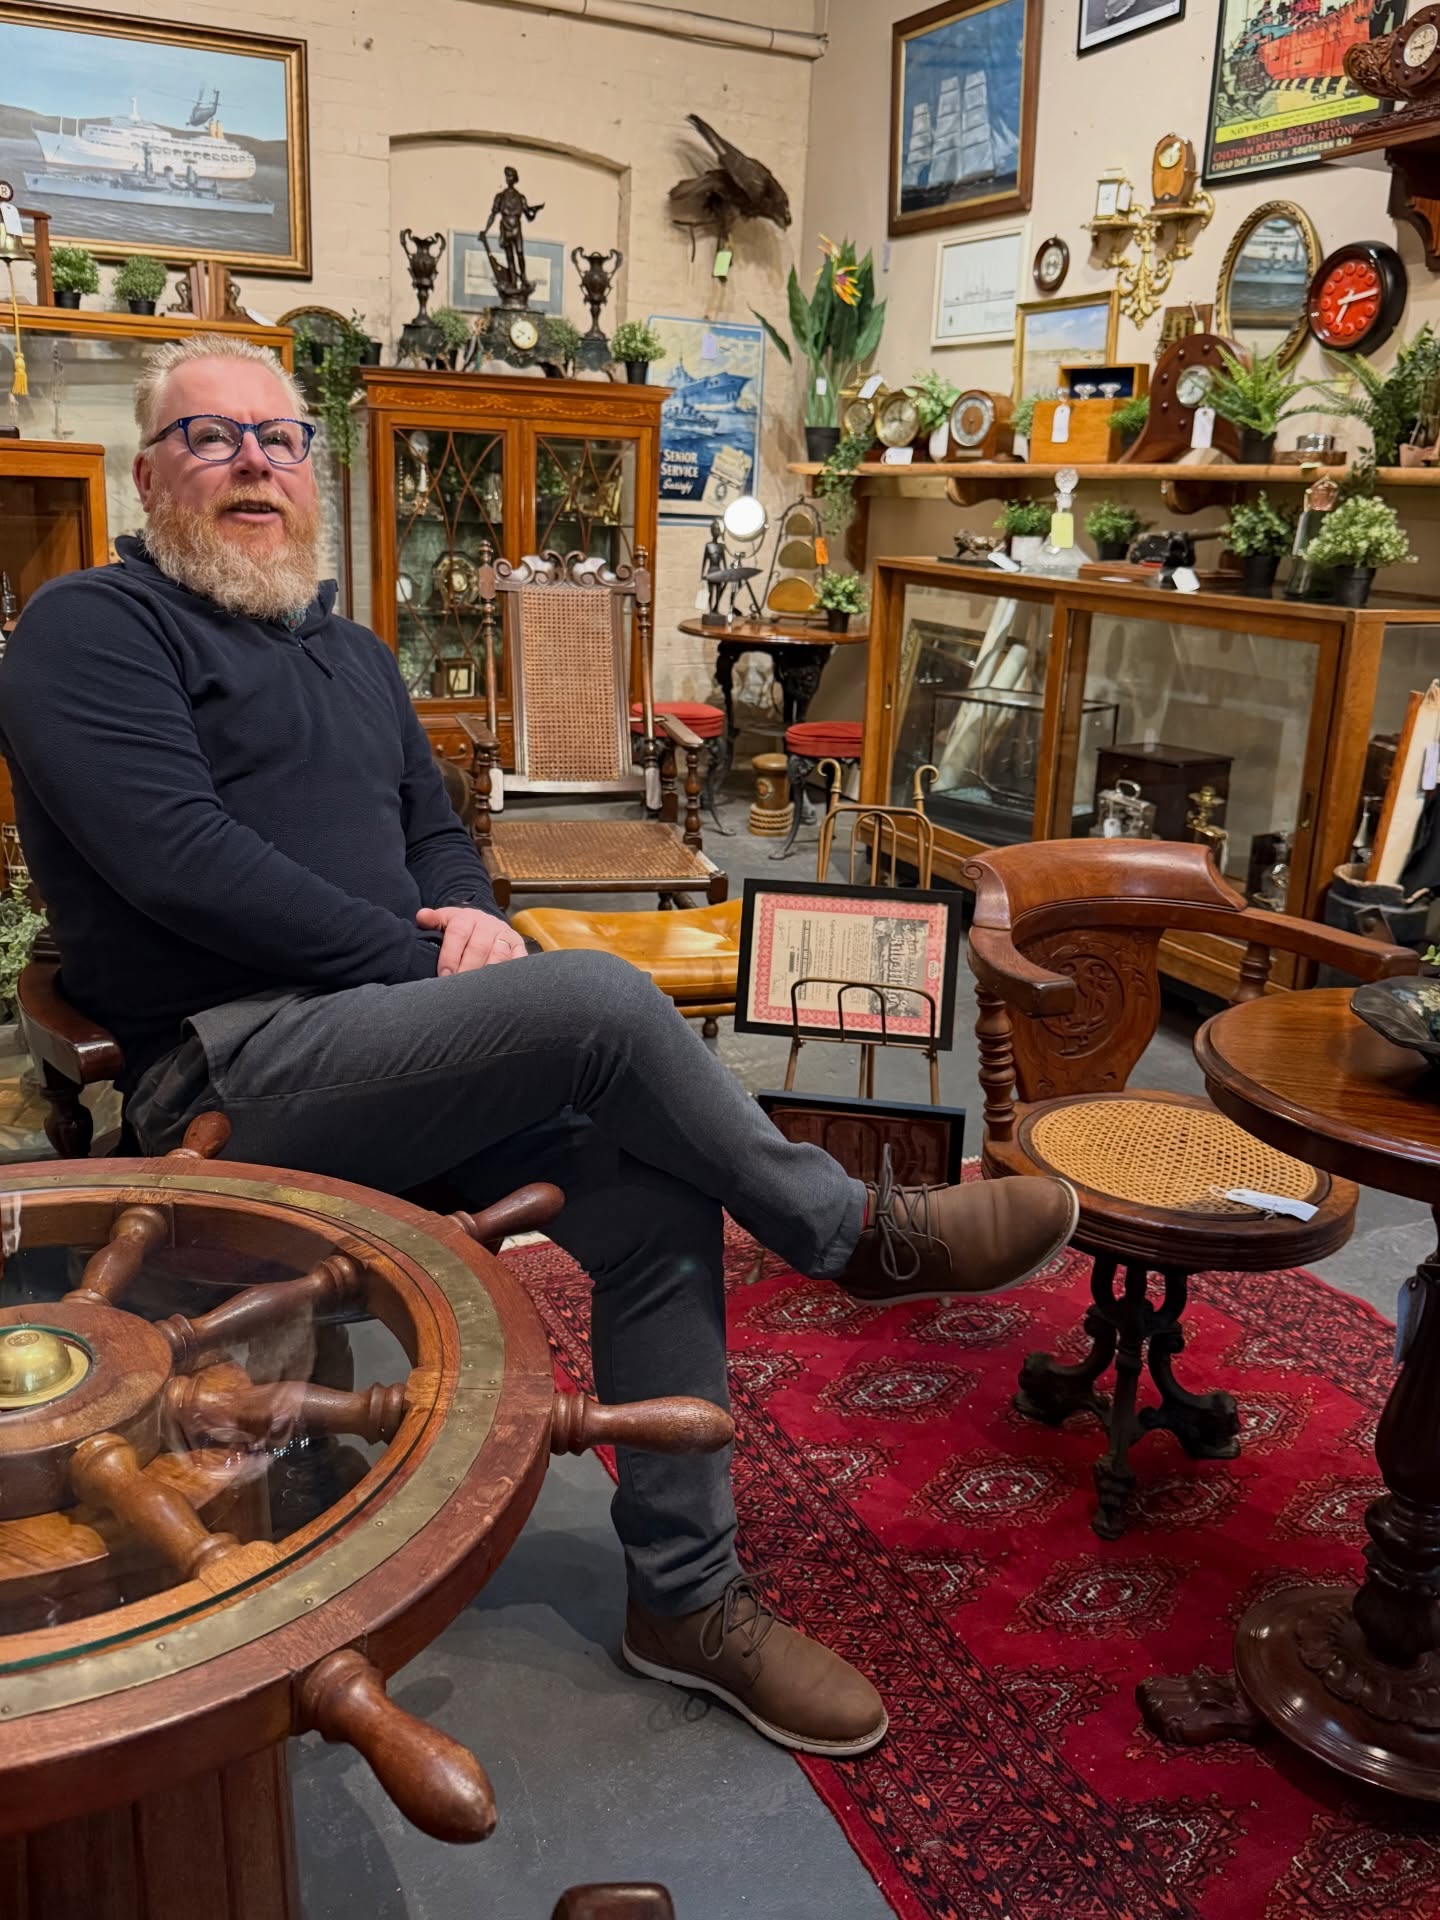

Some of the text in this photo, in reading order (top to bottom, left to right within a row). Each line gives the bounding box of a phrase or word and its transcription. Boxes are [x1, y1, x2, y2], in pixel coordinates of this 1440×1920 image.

[1247, 119, 1341, 144] VISIT THE DOCKYARDS
[1212, 160, 1233, 172] CHEAP
[1234, 158, 1249, 168] DAY
[1250, 152, 1279, 163] TICKETS
[1292, 140, 1335, 155] SOUTHERN
[1213, 147, 1253, 161] CHATHAM
[1256, 135, 1314, 152] PORTSMOUTH
[663, 449, 698, 464] SENIOR
[660, 463, 699, 478] SERVICE
